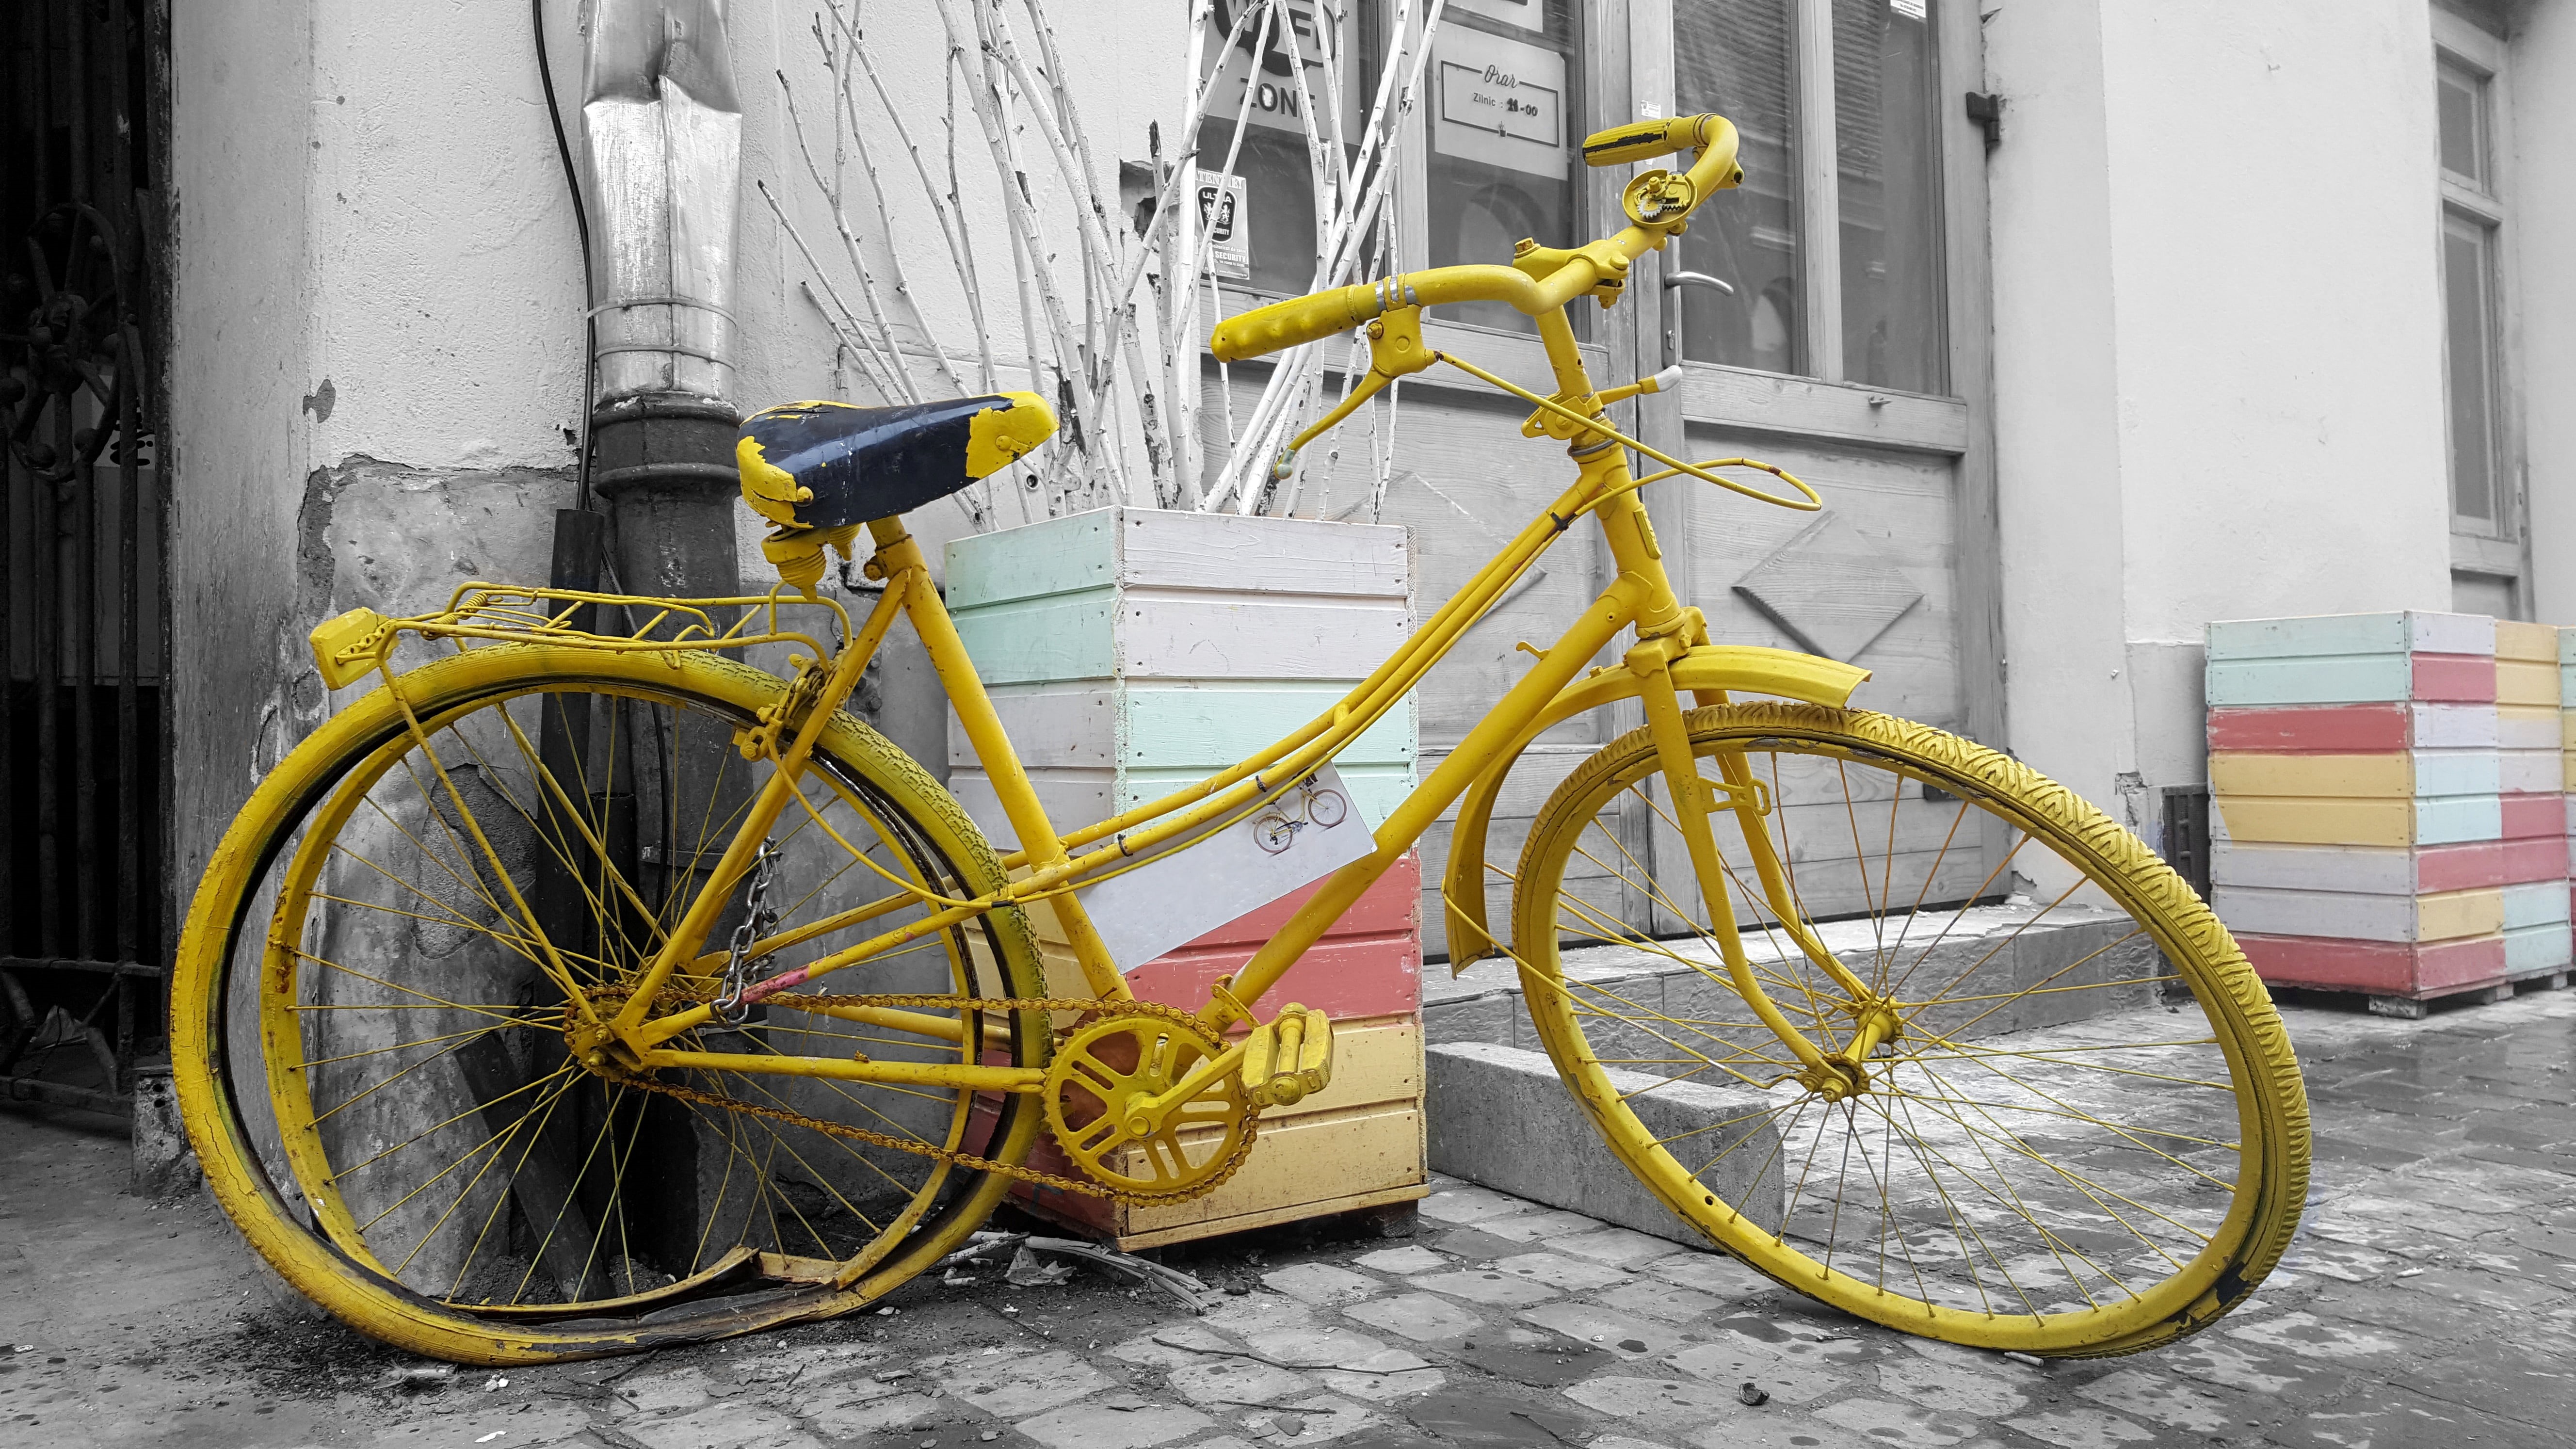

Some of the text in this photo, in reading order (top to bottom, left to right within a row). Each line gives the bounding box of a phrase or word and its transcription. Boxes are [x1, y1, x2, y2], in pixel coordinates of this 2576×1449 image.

[1484, 64, 1518, 89] Orar
[1473, 92, 1497, 107] Zilnic
[1213, 227, 1230, 236] CURITY
[1214, 250, 1246, 263] SECURITY
